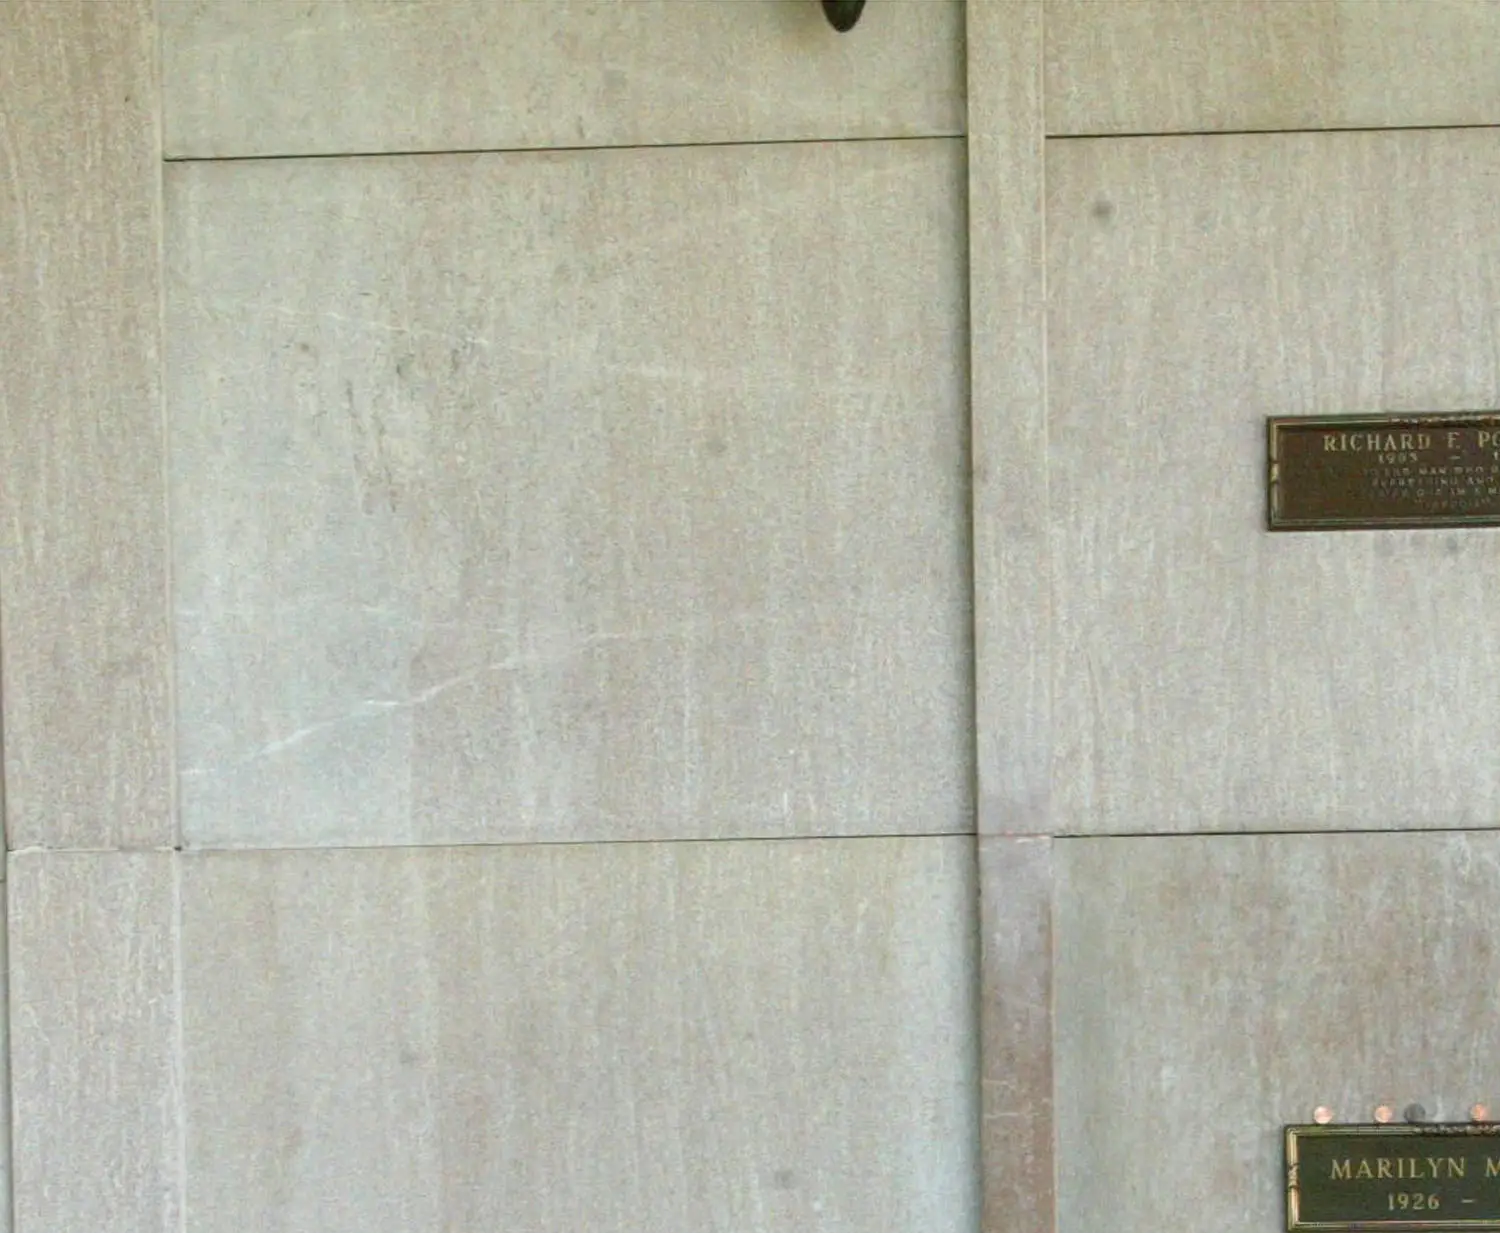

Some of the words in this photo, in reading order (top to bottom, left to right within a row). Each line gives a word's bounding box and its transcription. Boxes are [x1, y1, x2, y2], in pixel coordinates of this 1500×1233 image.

[1323, 433, 1431, 453] RICHARD
[1330, 1157, 1466, 1181] MARILYN
[1387, 1193, 1440, 1210] 1926
